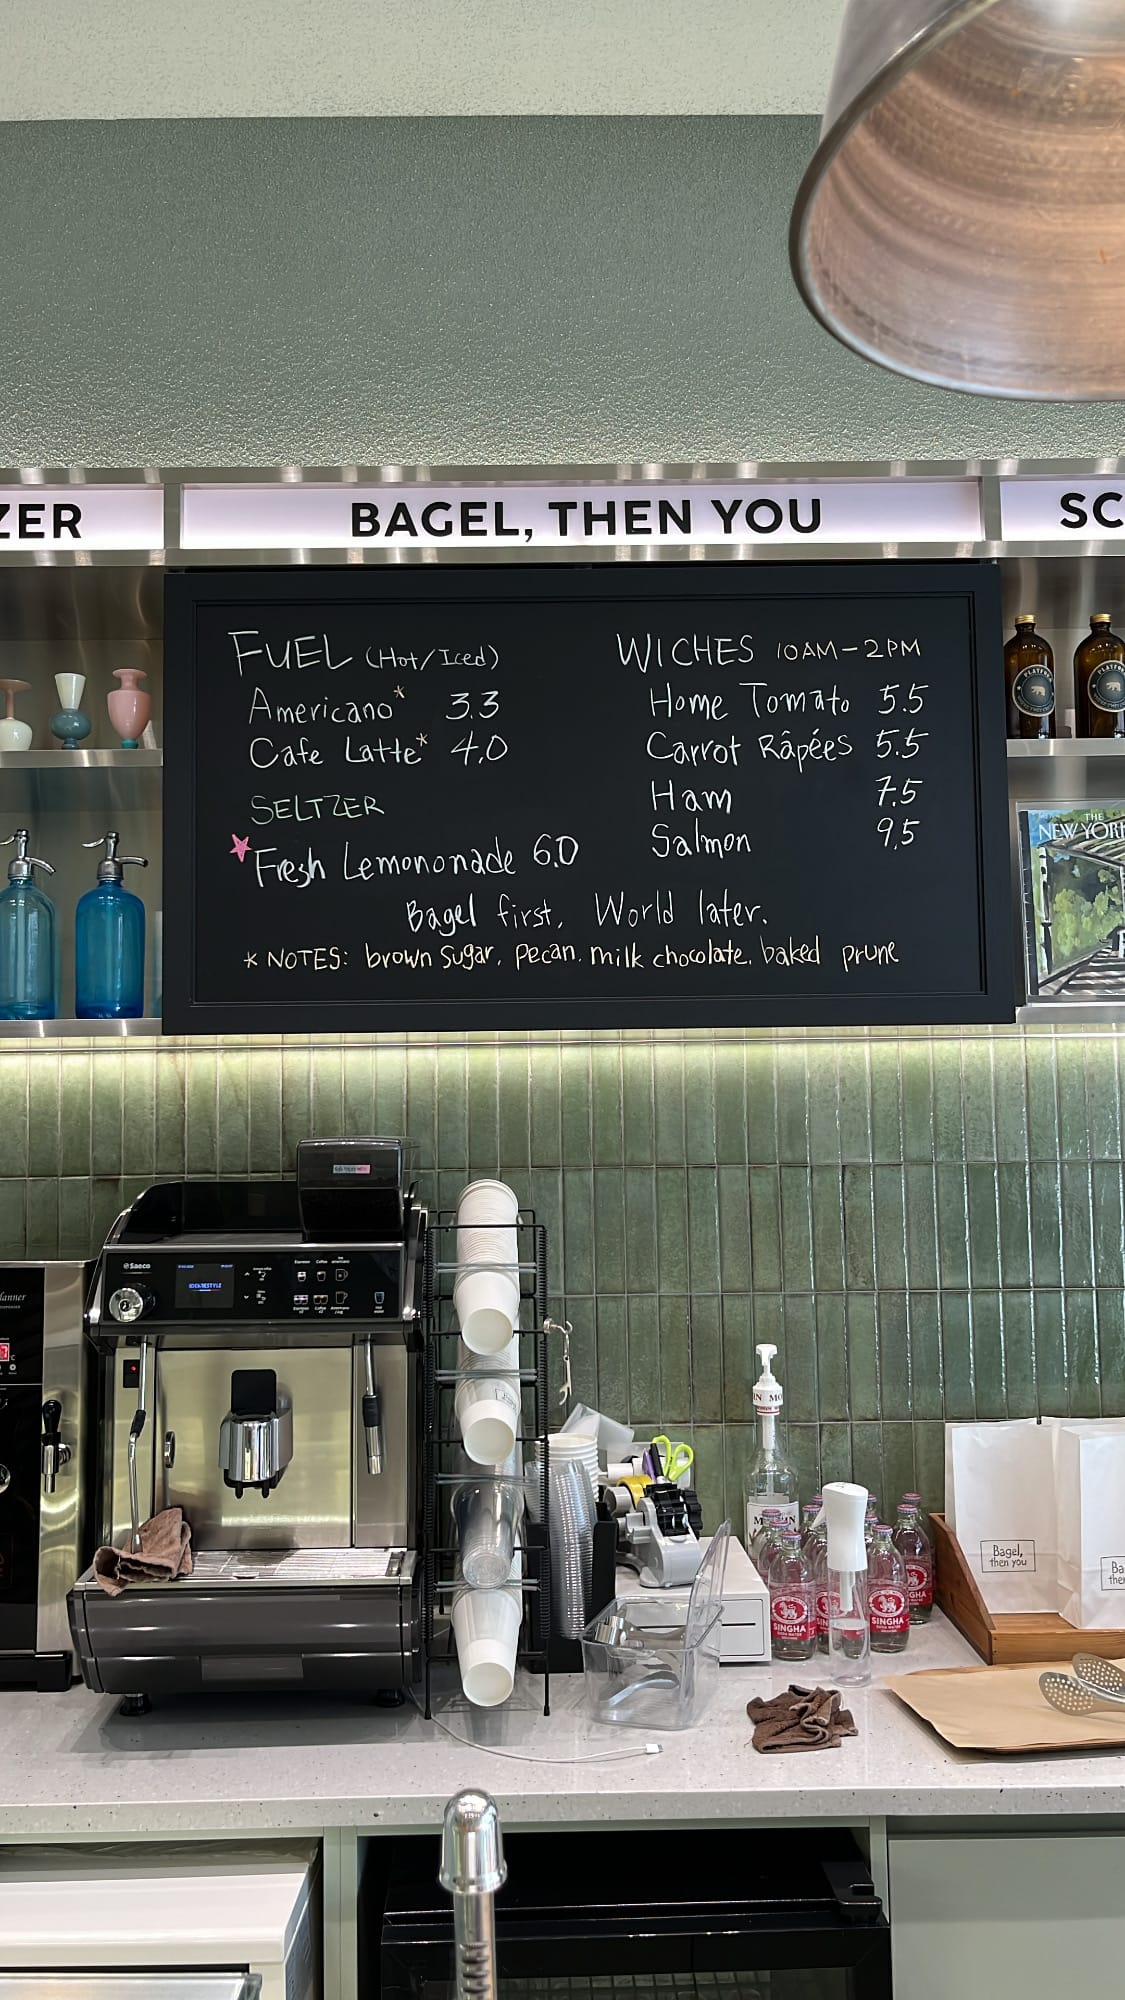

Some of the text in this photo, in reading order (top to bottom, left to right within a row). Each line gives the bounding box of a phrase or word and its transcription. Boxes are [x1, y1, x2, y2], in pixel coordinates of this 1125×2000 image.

[352, 499, 820, 542] BAGEL, THEN YOU
[1061, 492, 1123, 528] SC
[227, 630, 499, 677] FUEL (Hot/Iced)
[616, 633, 754, 674] WICHES
[445, 690, 500, 720] 3.3
[650, 682, 929, 721] Home Tomato 5.5
[249, 736, 324, 769] Cafe
[646, 728, 930, 774] Carrot Râpées 5.5
[251, 794, 385, 825] SELTZER
[651, 775, 924, 815] Ham 7.5
[651, 817, 921, 859] Salmon 9.5
[1039, 824, 1078, 840] NEW
[255, 847, 326, 888] Fresh
[533, 833, 579, 868] 6.0
[405, 888, 768, 937] Bagel first, World later.
[267, 946, 348, 971] NOTES:
[365, 942, 433, 969] brown
[590, 942, 645, 969] milk
[759, 934, 821, 968] baked
[842, 941, 900, 973] prune
[129, 1262, 151, 1270] Saeco
[990, 1557, 1027, 1568] then you
[993, 1544, 1023, 1559] Bagel,
[773, 1622, 807, 1633] SINGHA
[871, 1616, 905, 1626] SINGHA
